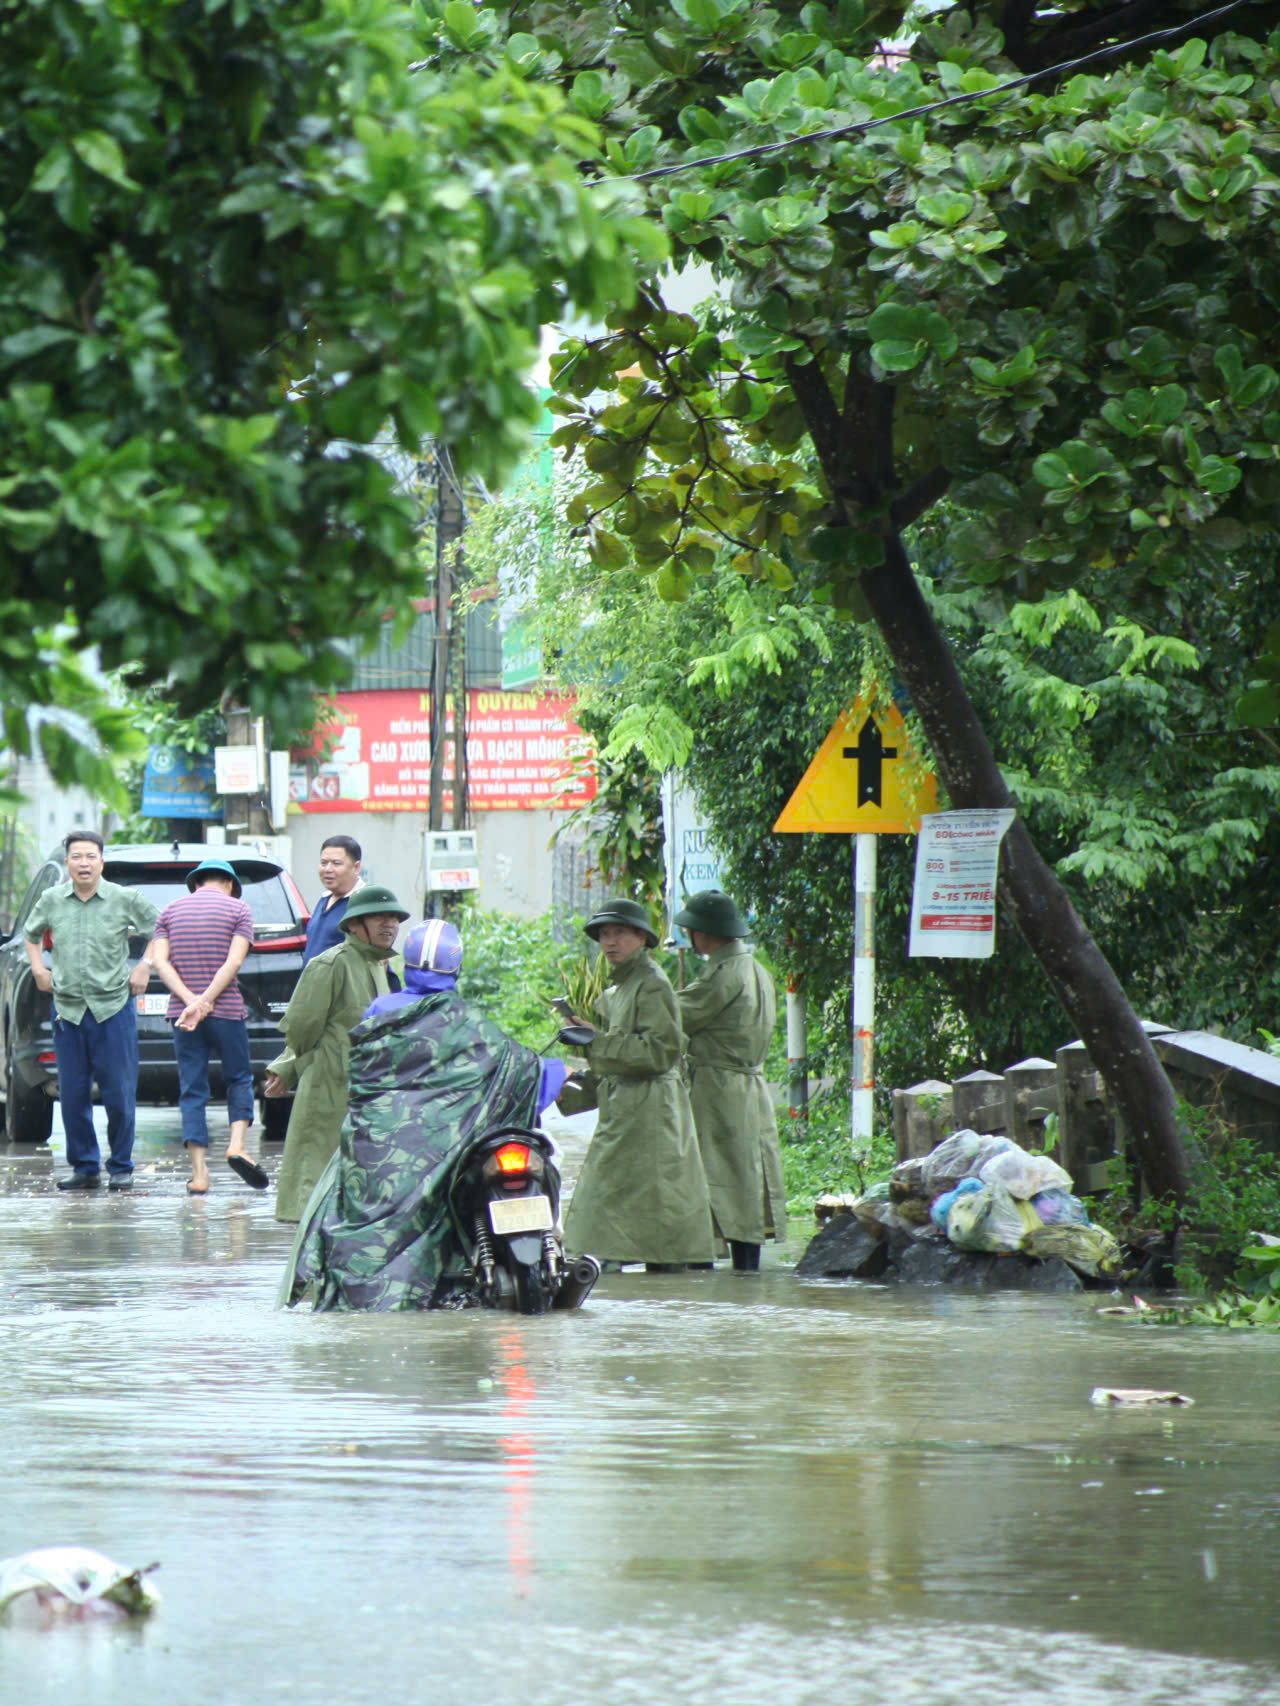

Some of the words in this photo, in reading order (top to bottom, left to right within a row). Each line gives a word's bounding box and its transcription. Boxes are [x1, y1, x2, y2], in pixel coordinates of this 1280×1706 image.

[371, 741, 397, 763] CAO
[487, 739, 523, 765] BẠCH
[685, 863, 719, 881] KEM
[932, 891, 960, 902] 9-15
